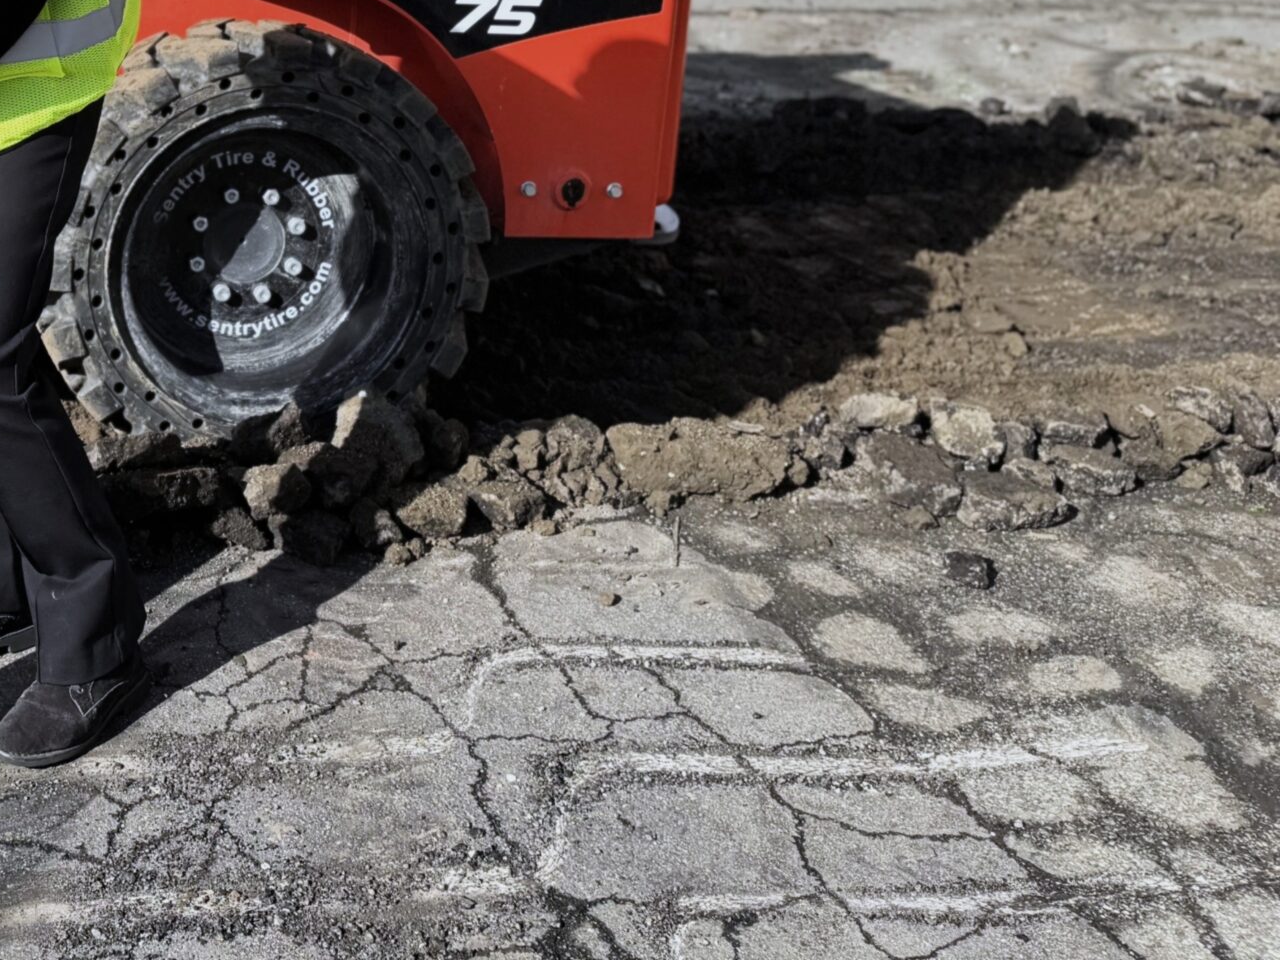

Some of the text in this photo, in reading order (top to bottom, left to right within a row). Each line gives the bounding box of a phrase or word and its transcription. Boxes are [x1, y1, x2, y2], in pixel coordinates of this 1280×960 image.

[153, 151, 335, 229] Sentry Tire & Rubber
[159, 261, 333, 339] www.sentrytire.com
